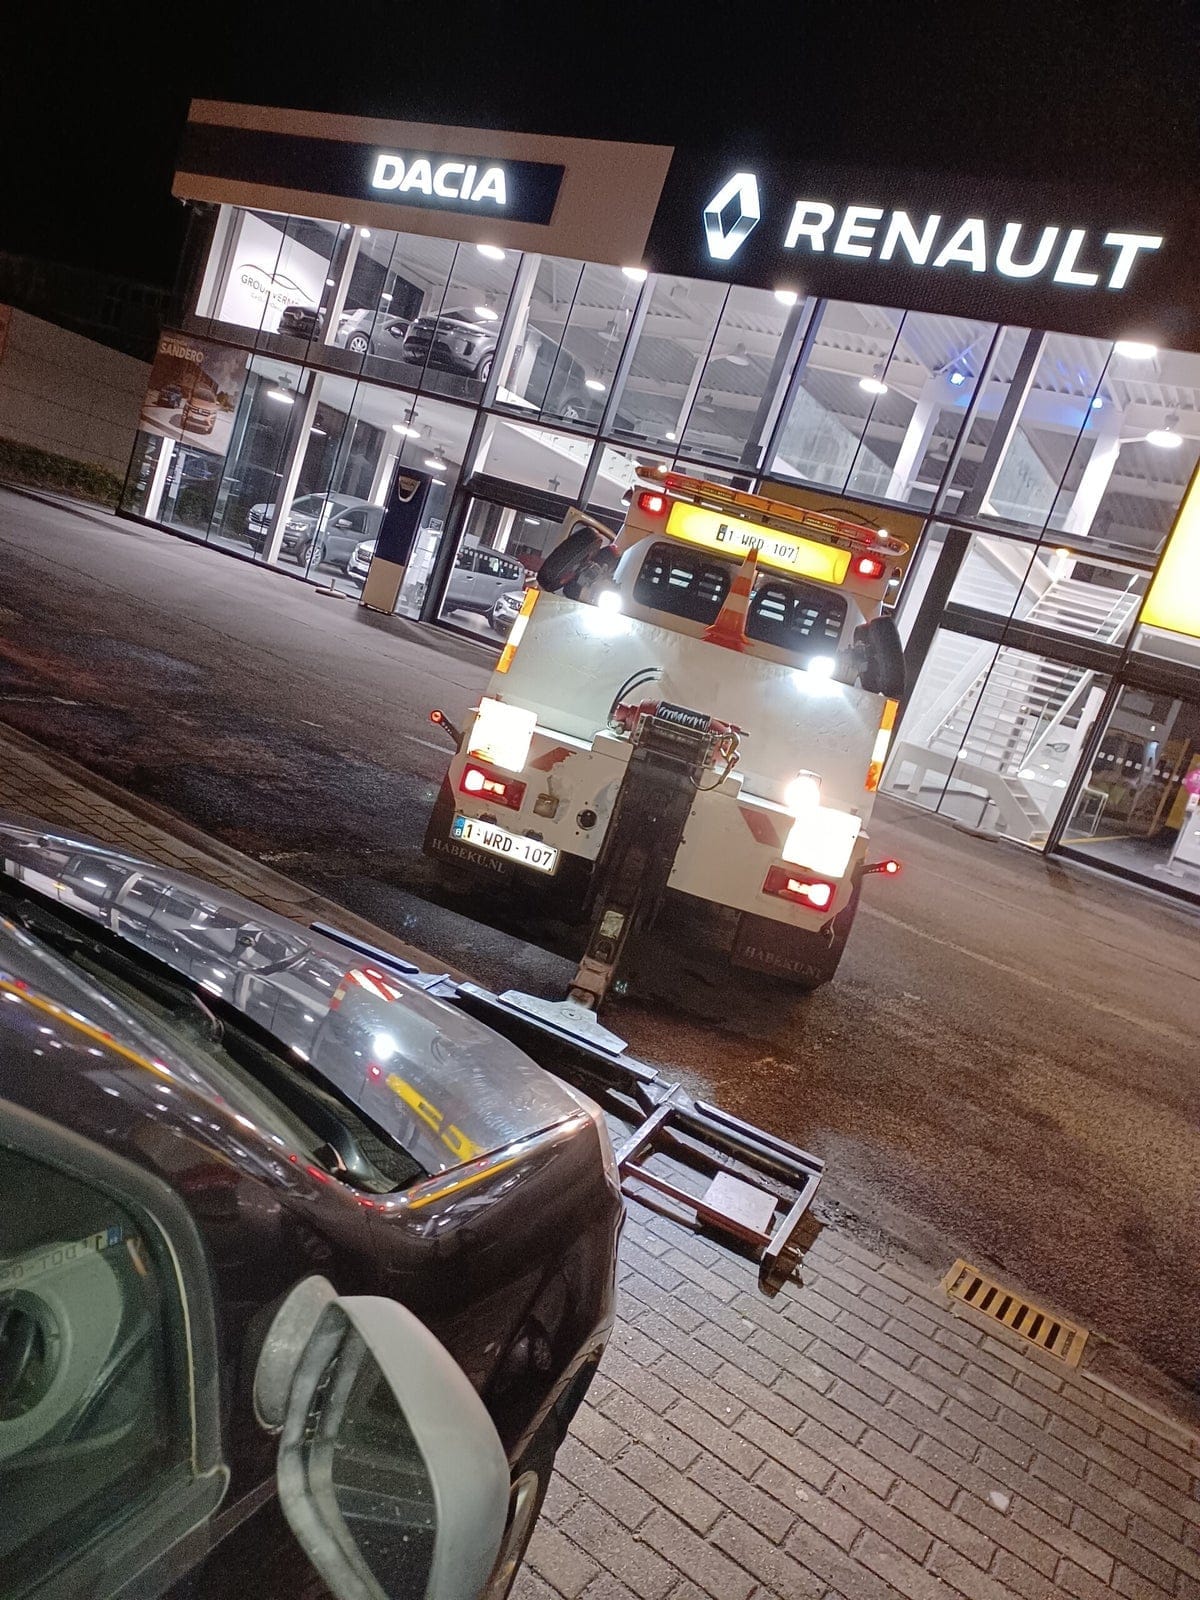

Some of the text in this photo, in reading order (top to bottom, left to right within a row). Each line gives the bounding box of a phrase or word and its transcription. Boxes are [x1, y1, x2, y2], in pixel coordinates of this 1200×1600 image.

[372, 155, 506, 204] DACIA
[784, 200, 1163, 289] RENAULT
[160, 342, 204, 362] SANDERO
[432, 838, 506, 873] HABEKU.NL
